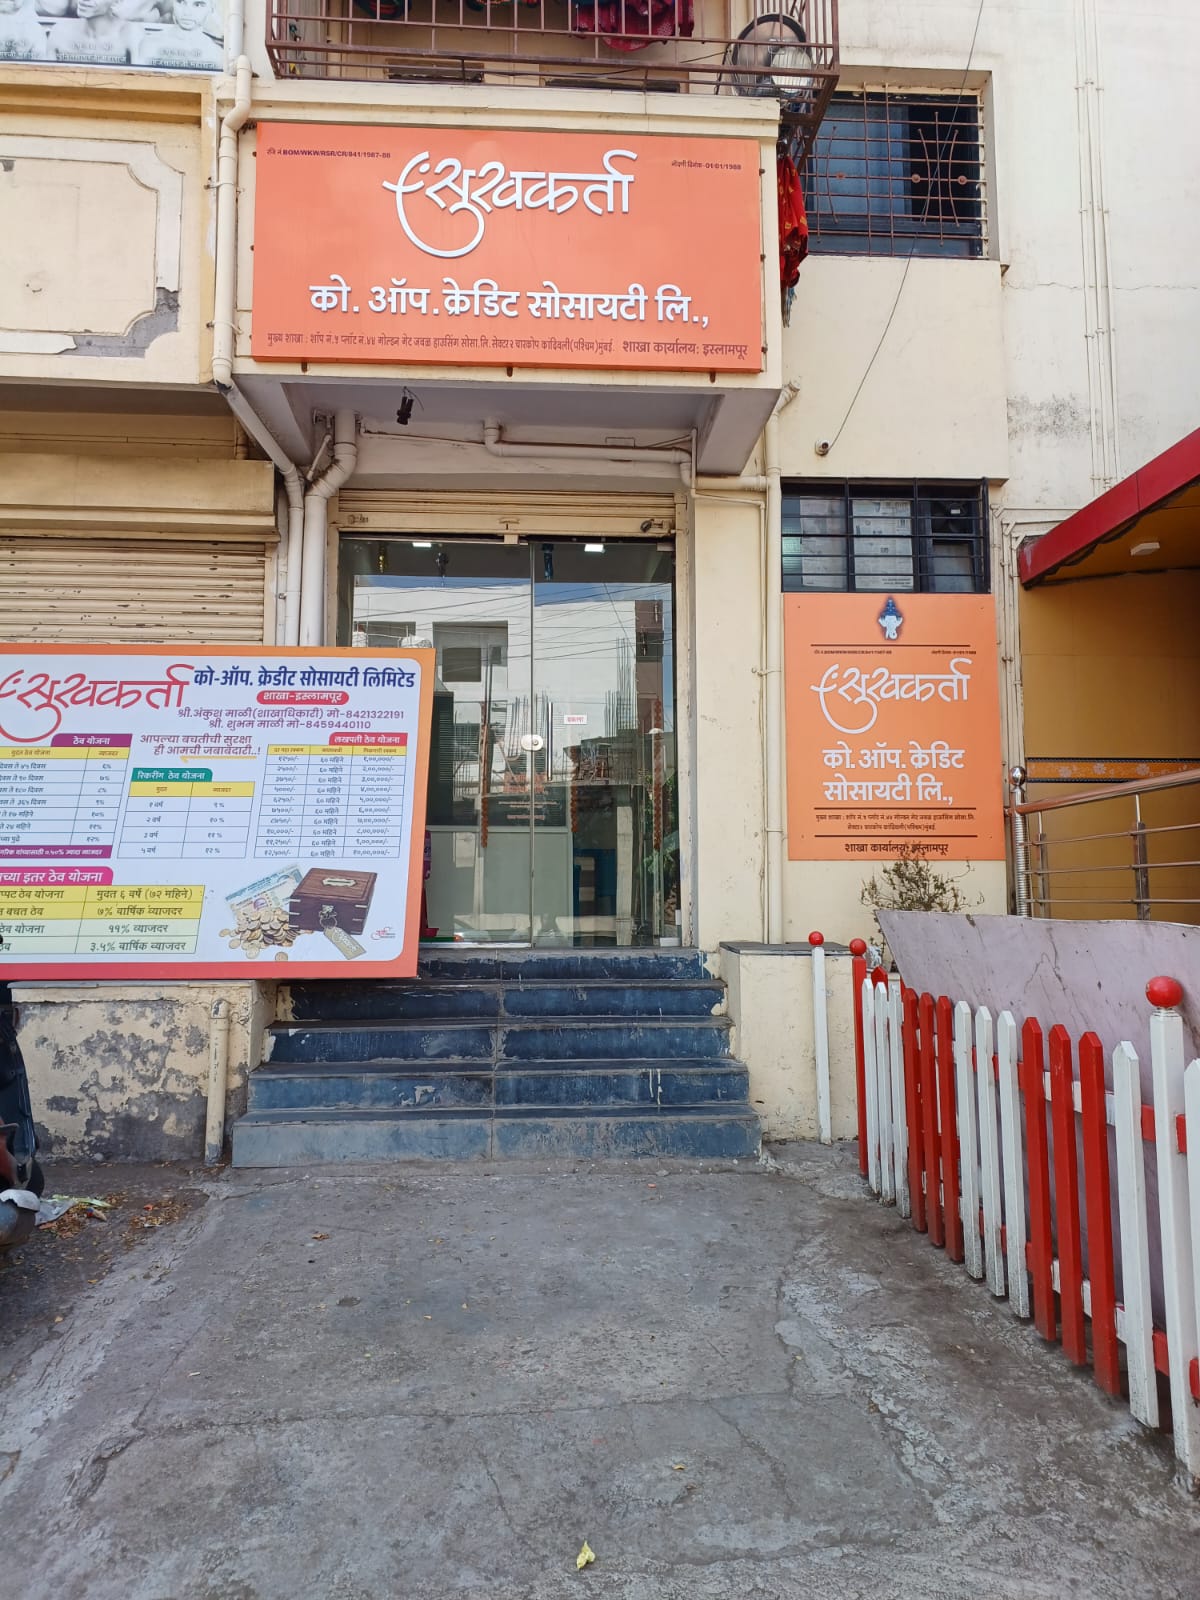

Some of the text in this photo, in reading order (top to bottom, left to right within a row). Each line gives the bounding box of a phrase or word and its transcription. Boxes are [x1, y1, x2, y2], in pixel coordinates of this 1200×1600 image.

[382, 150, 638, 258] सुखकर्ता
[310, 274, 359, 313] को.
[526, 280, 648, 321] सोसायटी
[622, 340, 651, 353] शाखा
[702, 343, 748, 360] इस्लामपूर
[300, 666, 359, 688] सोसायटी
[363, 667, 416, 688] लिमिटेड
[810, 657, 972, 735] सुखकर्ता
[227, 719, 254, 731] शुभम
[257, 718, 284, 729] माळी
[72, 736, 111, 745] ठेव योजना
[139, 732, 253, 747] आपल्या बचतीची सुरक्षा
[334, 736, 401, 745] लखपती ठेव योजना
[153, 743, 165, 756] ही
[167, 743, 201, 756] आमची
[167, 770, 179, 780] ठेव
[181, 770, 205, 780] योजना
[822, 773, 913, 801] सोसायटी
[844, 843, 868, 853] शाखा
[23, 871, 104, 884] इतर ठेव योजना
[18, 889, 33, 899] ठेव
[34, 889, 65, 900] योजना
[96, 890, 117, 901] मुदत
[6, 907, 28, 916] बचत
[30, 906, 44, 916] ठेव
[97, 905, 183, 916] ७% वार्षिक व्याजदर
[14, 923, 45, 934] योजना
[133, 924, 169, 933] व्याजदर
[118, 941, 147, 952] वार्षिक
[150, 942, 186, 952] व्याजदर
